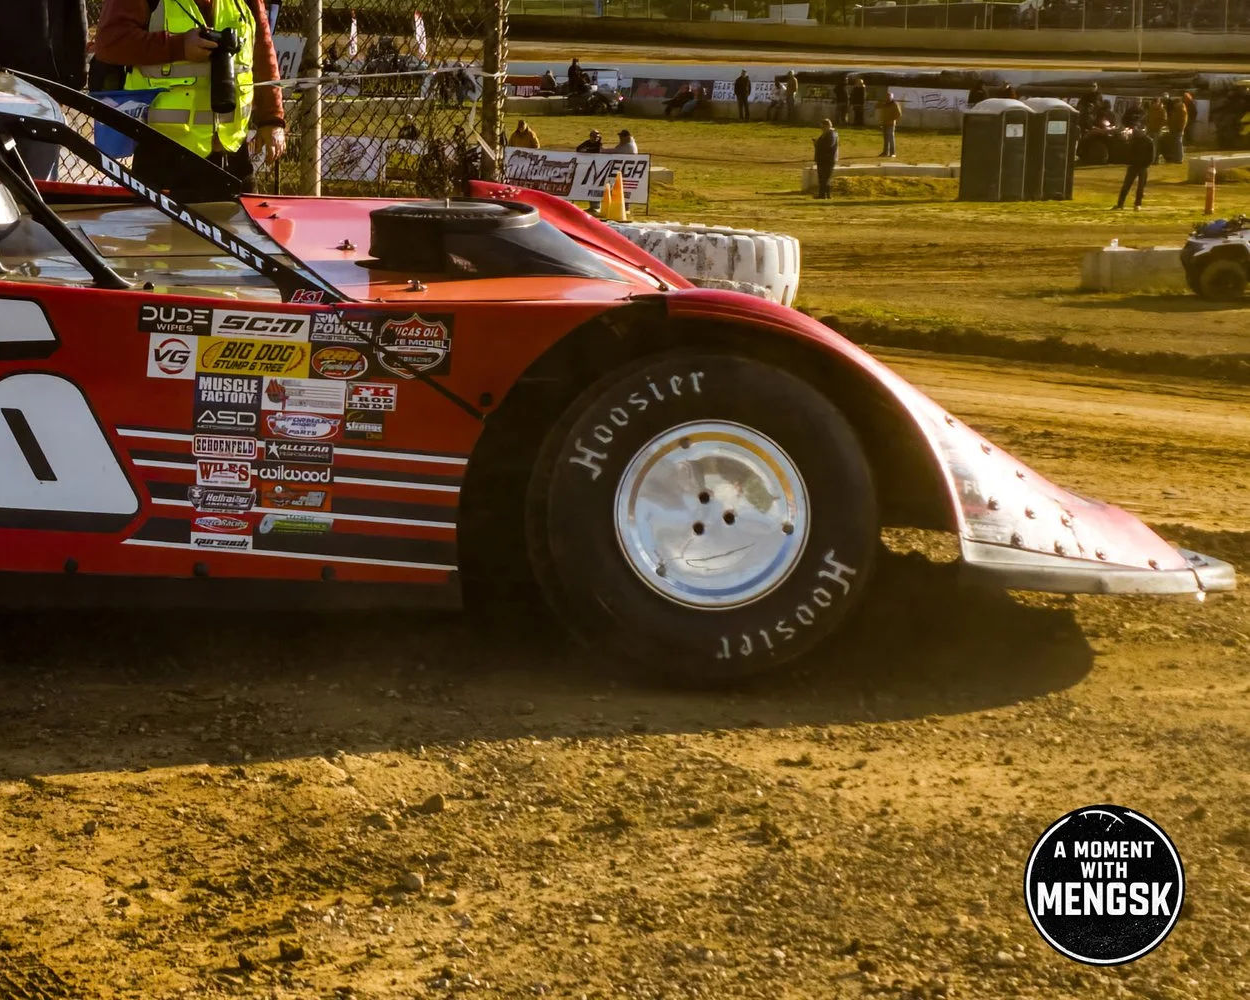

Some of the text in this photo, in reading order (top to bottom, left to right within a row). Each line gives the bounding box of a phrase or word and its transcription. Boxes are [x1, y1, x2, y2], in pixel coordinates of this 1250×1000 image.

[582, 160, 648, 187] MEGA
[142, 306, 209, 324] DUDE
[157, 323, 193, 332] WIPES
[391, 326, 439, 337] UCAS OIL
[220, 341, 296, 362] BIG DOG
[408, 339, 448, 349] MODEL
[154, 349, 191, 365] VG
[212, 359, 249, 371] STUMP
[258, 363, 285, 373] TREE
[199, 377, 258, 393] MUSCLE
[201, 391, 255, 404] FACTORY
[197, 410, 256, 426] ASD
[569, 370, 705, 480] Hoosier
[196, 438, 254, 455] SCHOENFELD
[279, 443, 329, 453] ALLSTAR
[199, 462, 249, 482] WILES
[259, 465, 331, 483] wilwood
[716, 549, 857, 660] Hoosier
